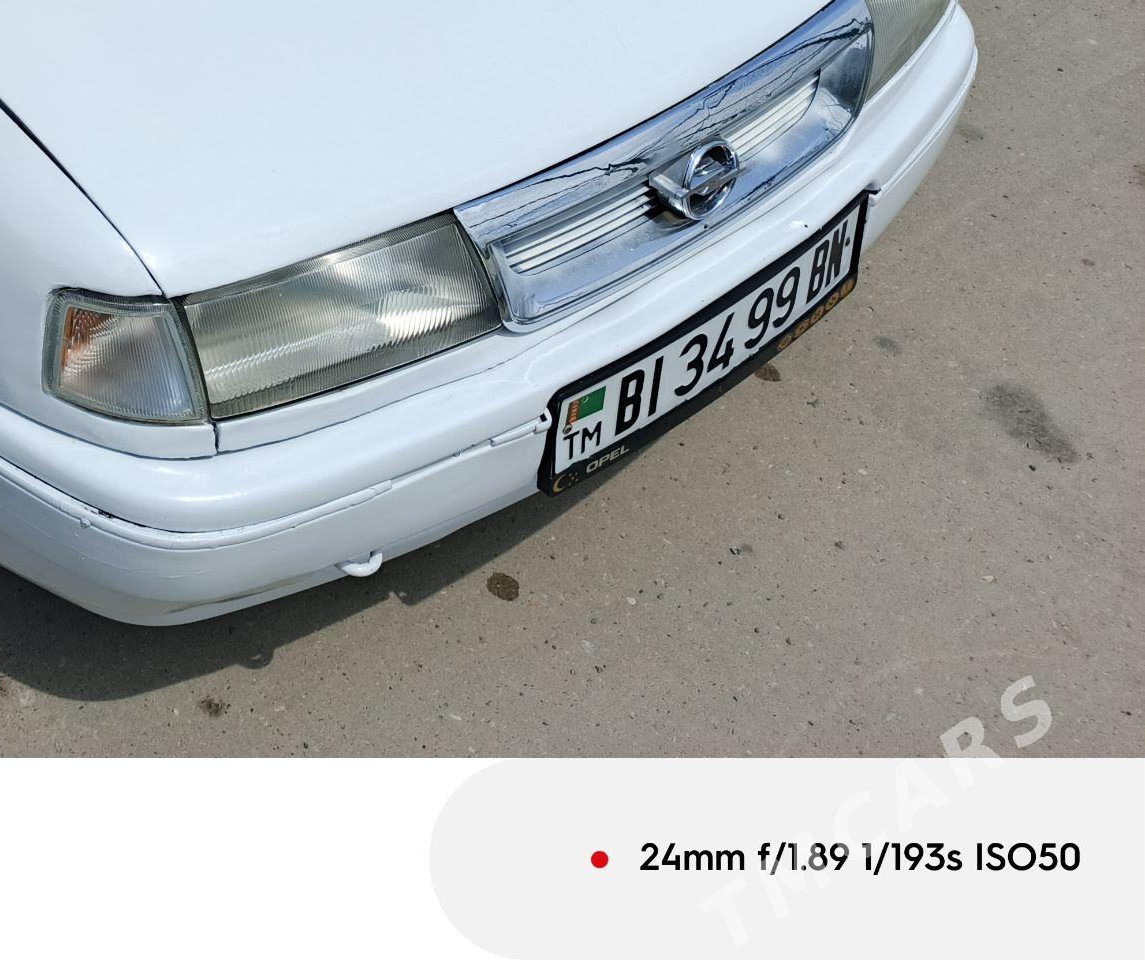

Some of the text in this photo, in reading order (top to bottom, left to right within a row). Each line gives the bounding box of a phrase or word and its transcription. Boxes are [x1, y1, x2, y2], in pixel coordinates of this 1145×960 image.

[615, 356, 663, 436] BI
[806, 219, 848, 304] BN
[563, 421, 602, 460] TM
[586, 445, 630, 474] OPEL
